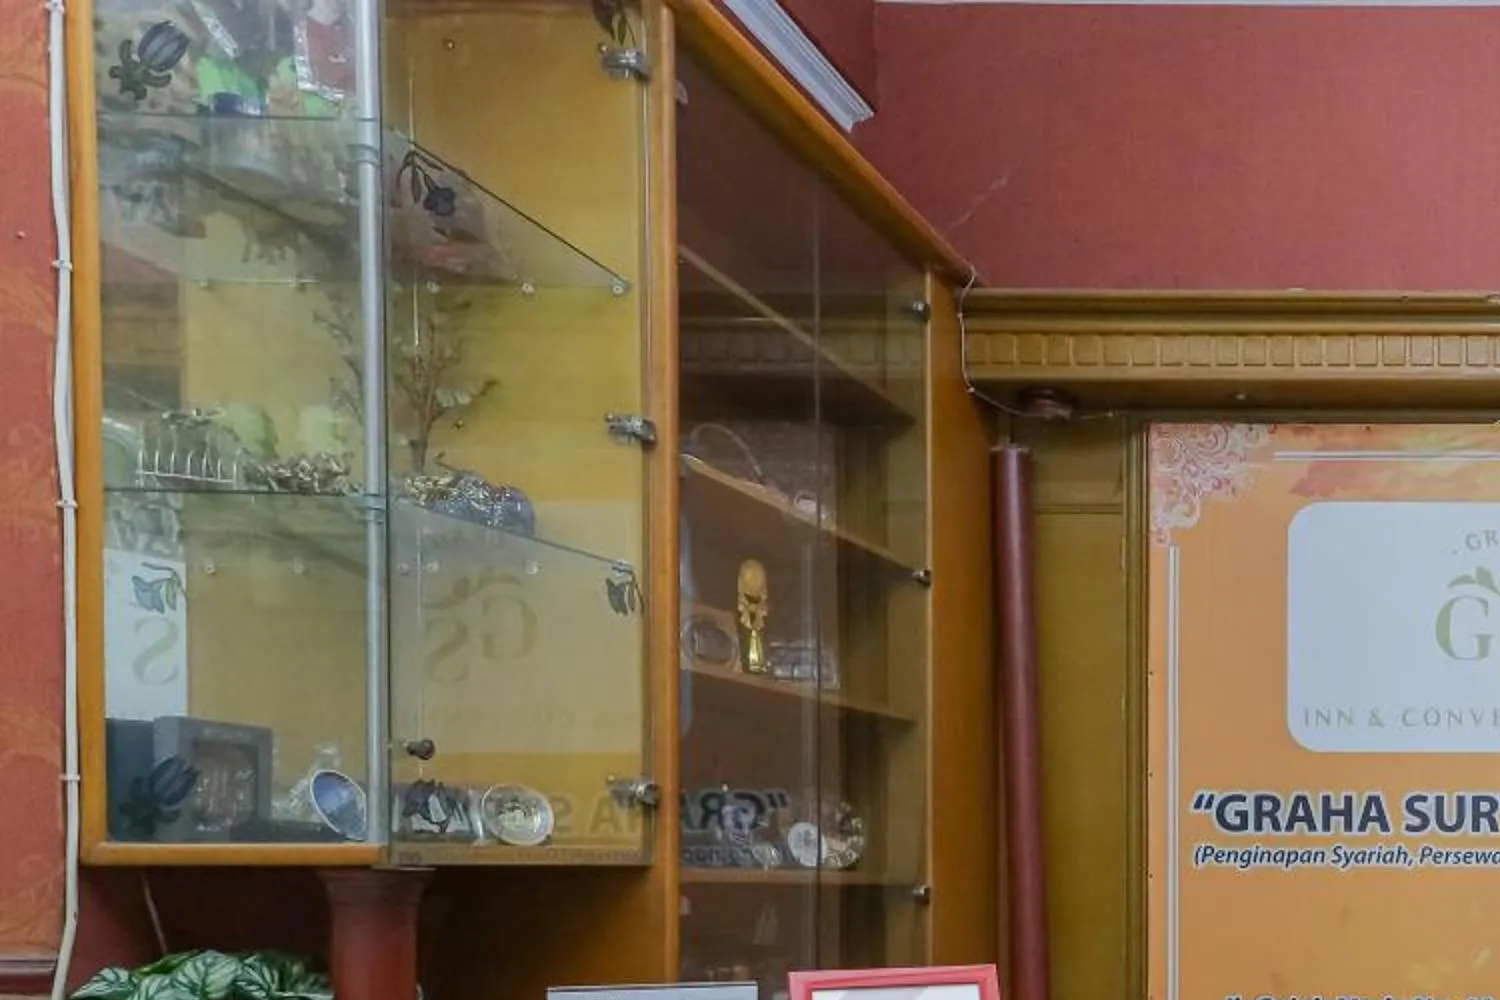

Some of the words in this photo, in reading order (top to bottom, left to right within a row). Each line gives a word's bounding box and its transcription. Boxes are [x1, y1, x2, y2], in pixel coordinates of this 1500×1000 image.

[1303, 706, 1355, 728] INN
[1367, 706, 1385, 728] &
[1194, 845, 1325, 868] (Penginapan
[1332, 845, 1414, 869] Syariah,
